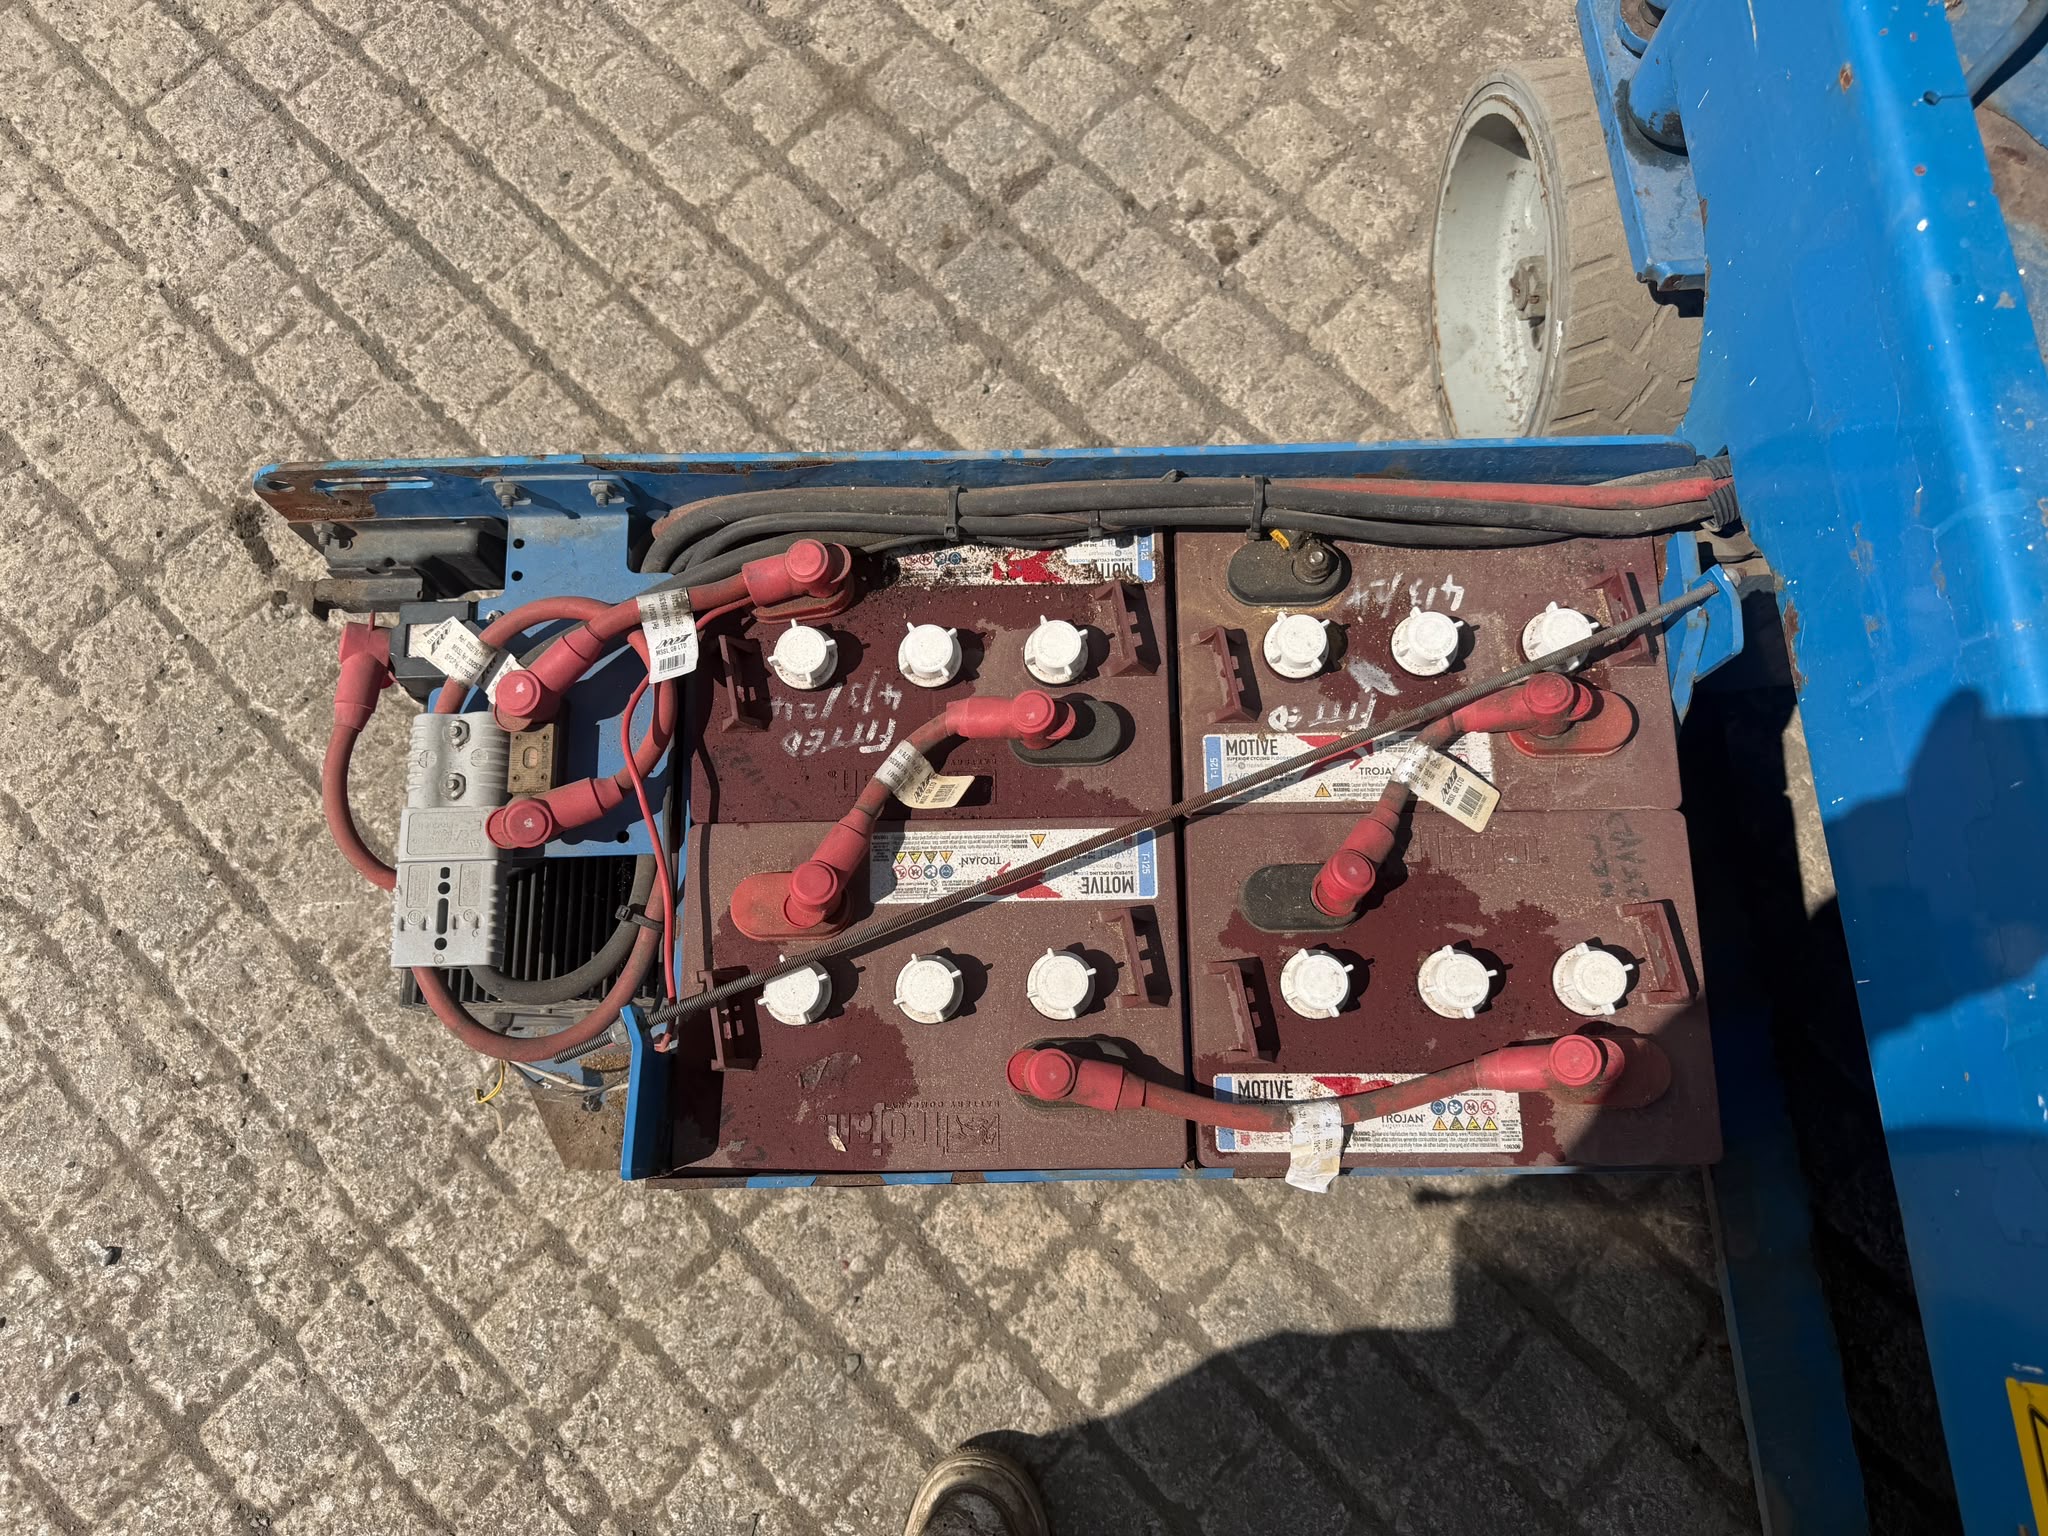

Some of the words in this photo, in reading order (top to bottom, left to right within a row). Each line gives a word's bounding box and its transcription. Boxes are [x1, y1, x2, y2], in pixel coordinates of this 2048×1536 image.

[781, 717, 896, 758] FITTED
[1226, 738, 1279, 757] MOTIVE
[1210, 756, 1219, 780] T-125
[960, 856, 1001, 866] TROJAN
[1141, 852, 1150, 874] T-125
[1081, 875, 1134, 894] MOTIVE
[1238, 1079, 1293, 1099] MOTIVE
[951, 1100, 1001, 1108] BATTERY
[827, 1102, 947, 1155] Trojan
